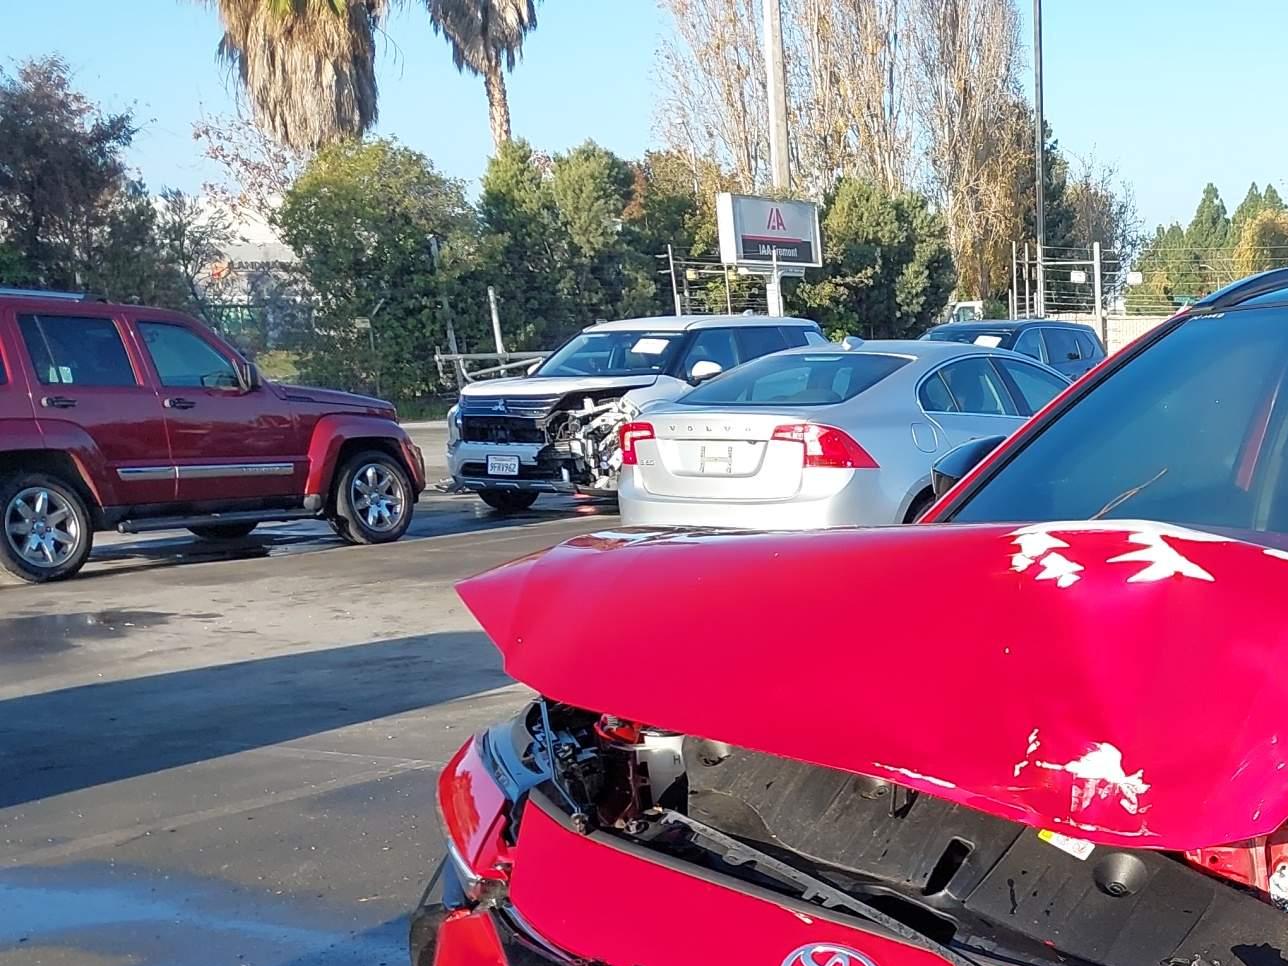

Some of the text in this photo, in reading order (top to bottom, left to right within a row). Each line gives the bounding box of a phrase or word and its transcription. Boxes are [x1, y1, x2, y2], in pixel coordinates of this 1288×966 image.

[759, 244, 798, 257] IAA Fremont
[668, 425, 752, 433] VOLVO
[673, 754, 681, 765] H
